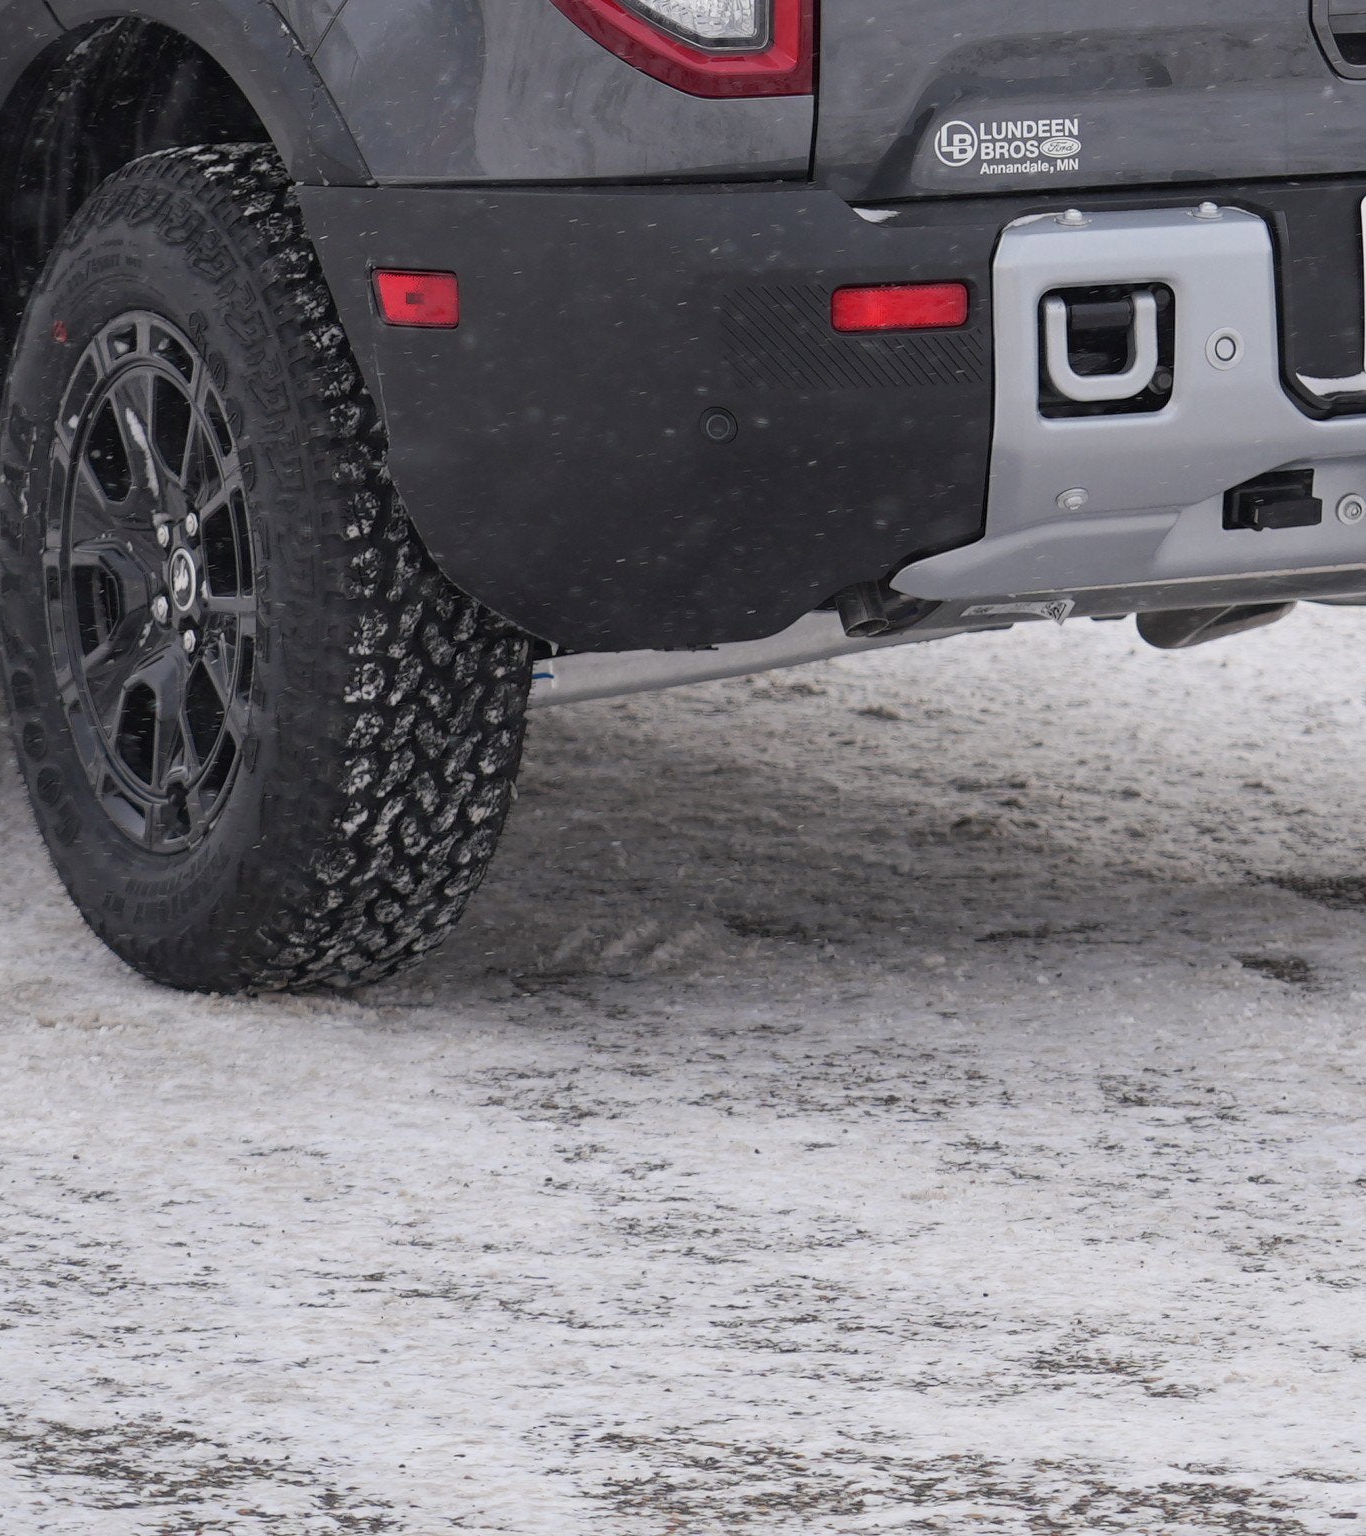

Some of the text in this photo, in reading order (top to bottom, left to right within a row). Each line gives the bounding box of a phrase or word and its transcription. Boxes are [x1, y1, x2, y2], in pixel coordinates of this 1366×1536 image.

[979, 118, 1079, 140] LUNDEEN
[980, 140, 1040, 161] BROS
[979, 158, 1079, 175] Annandale, MN
